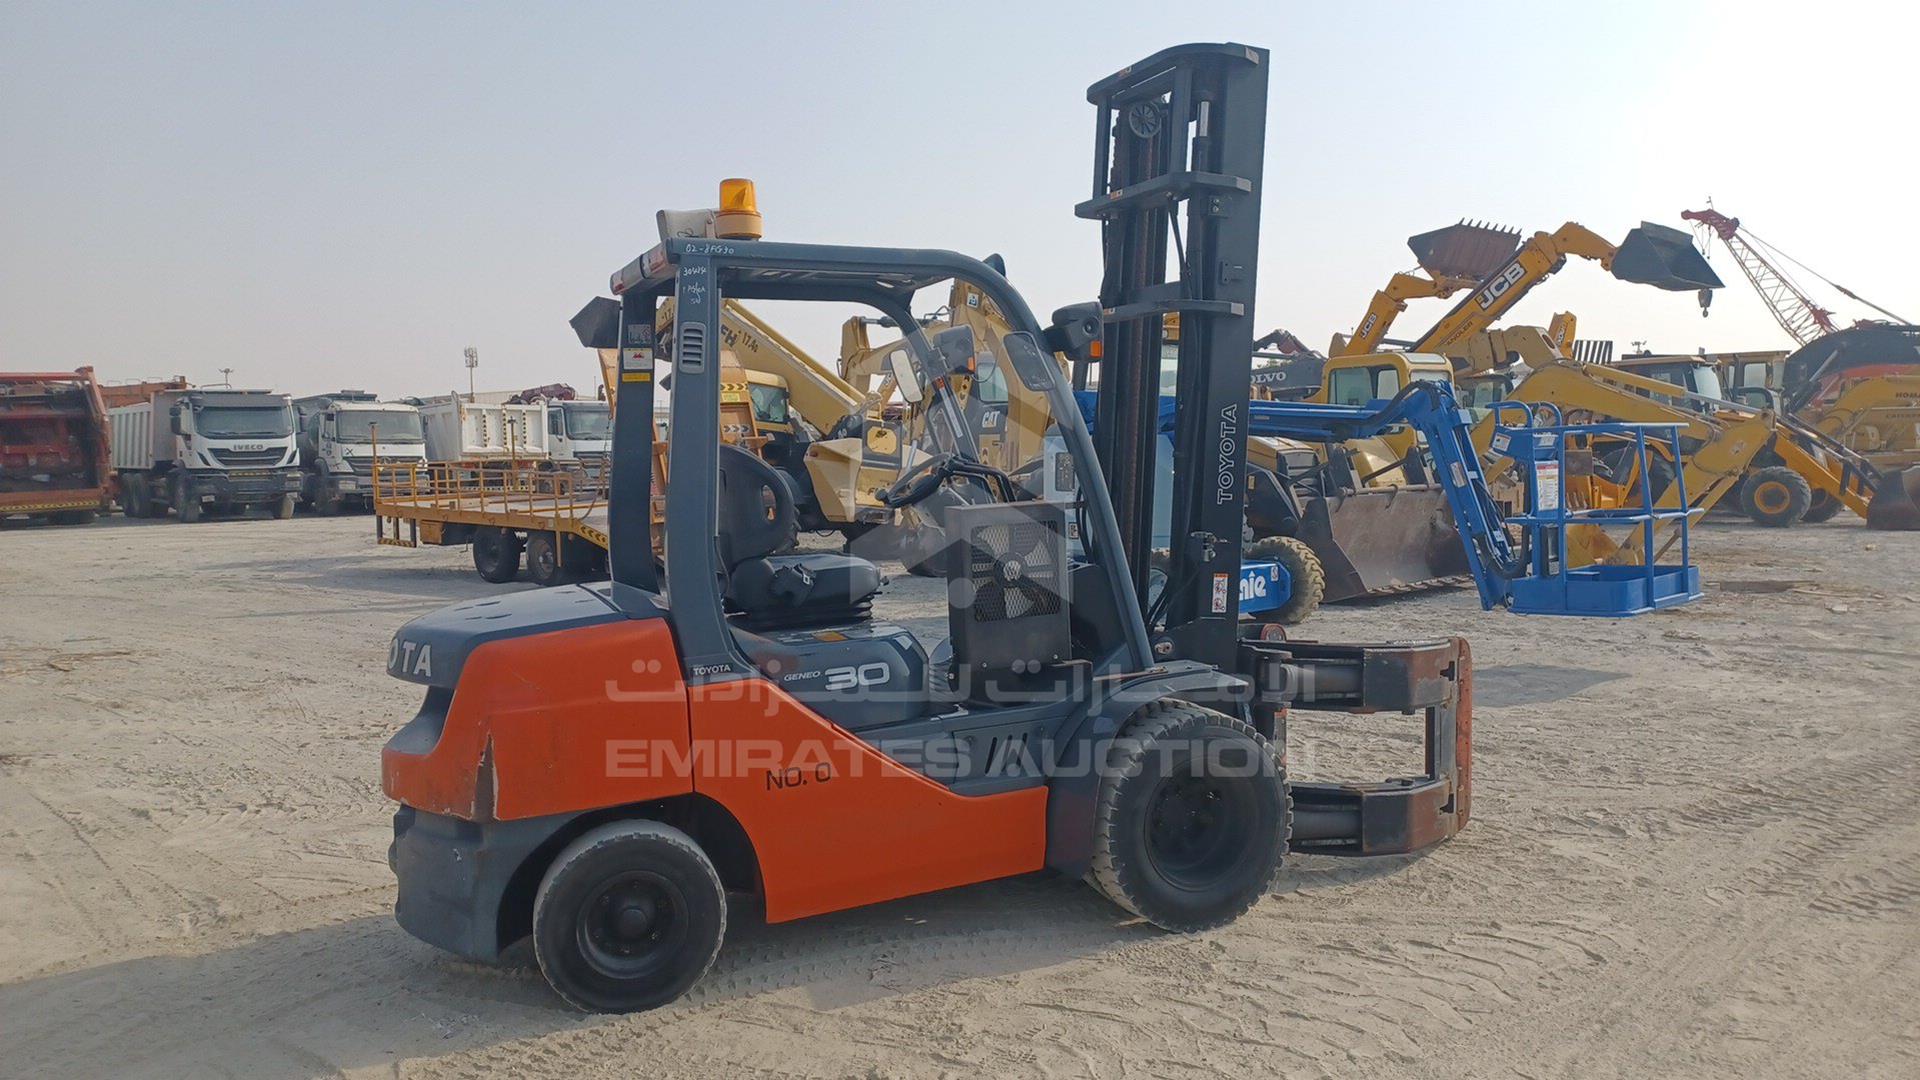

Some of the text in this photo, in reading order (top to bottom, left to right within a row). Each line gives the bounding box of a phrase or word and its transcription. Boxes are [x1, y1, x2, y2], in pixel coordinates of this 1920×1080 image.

[1475, 261, 1527, 309] JCB
[1361, 312, 1377, 339] JCB
[982, 410, 1000, 428] CAT
[1217, 403, 1237, 505] TOYOTA
[693, 663, 731, 676] TOYOTA
[784, 662, 890, 691] GENEO 30
[766, 766, 807, 791] NO.
